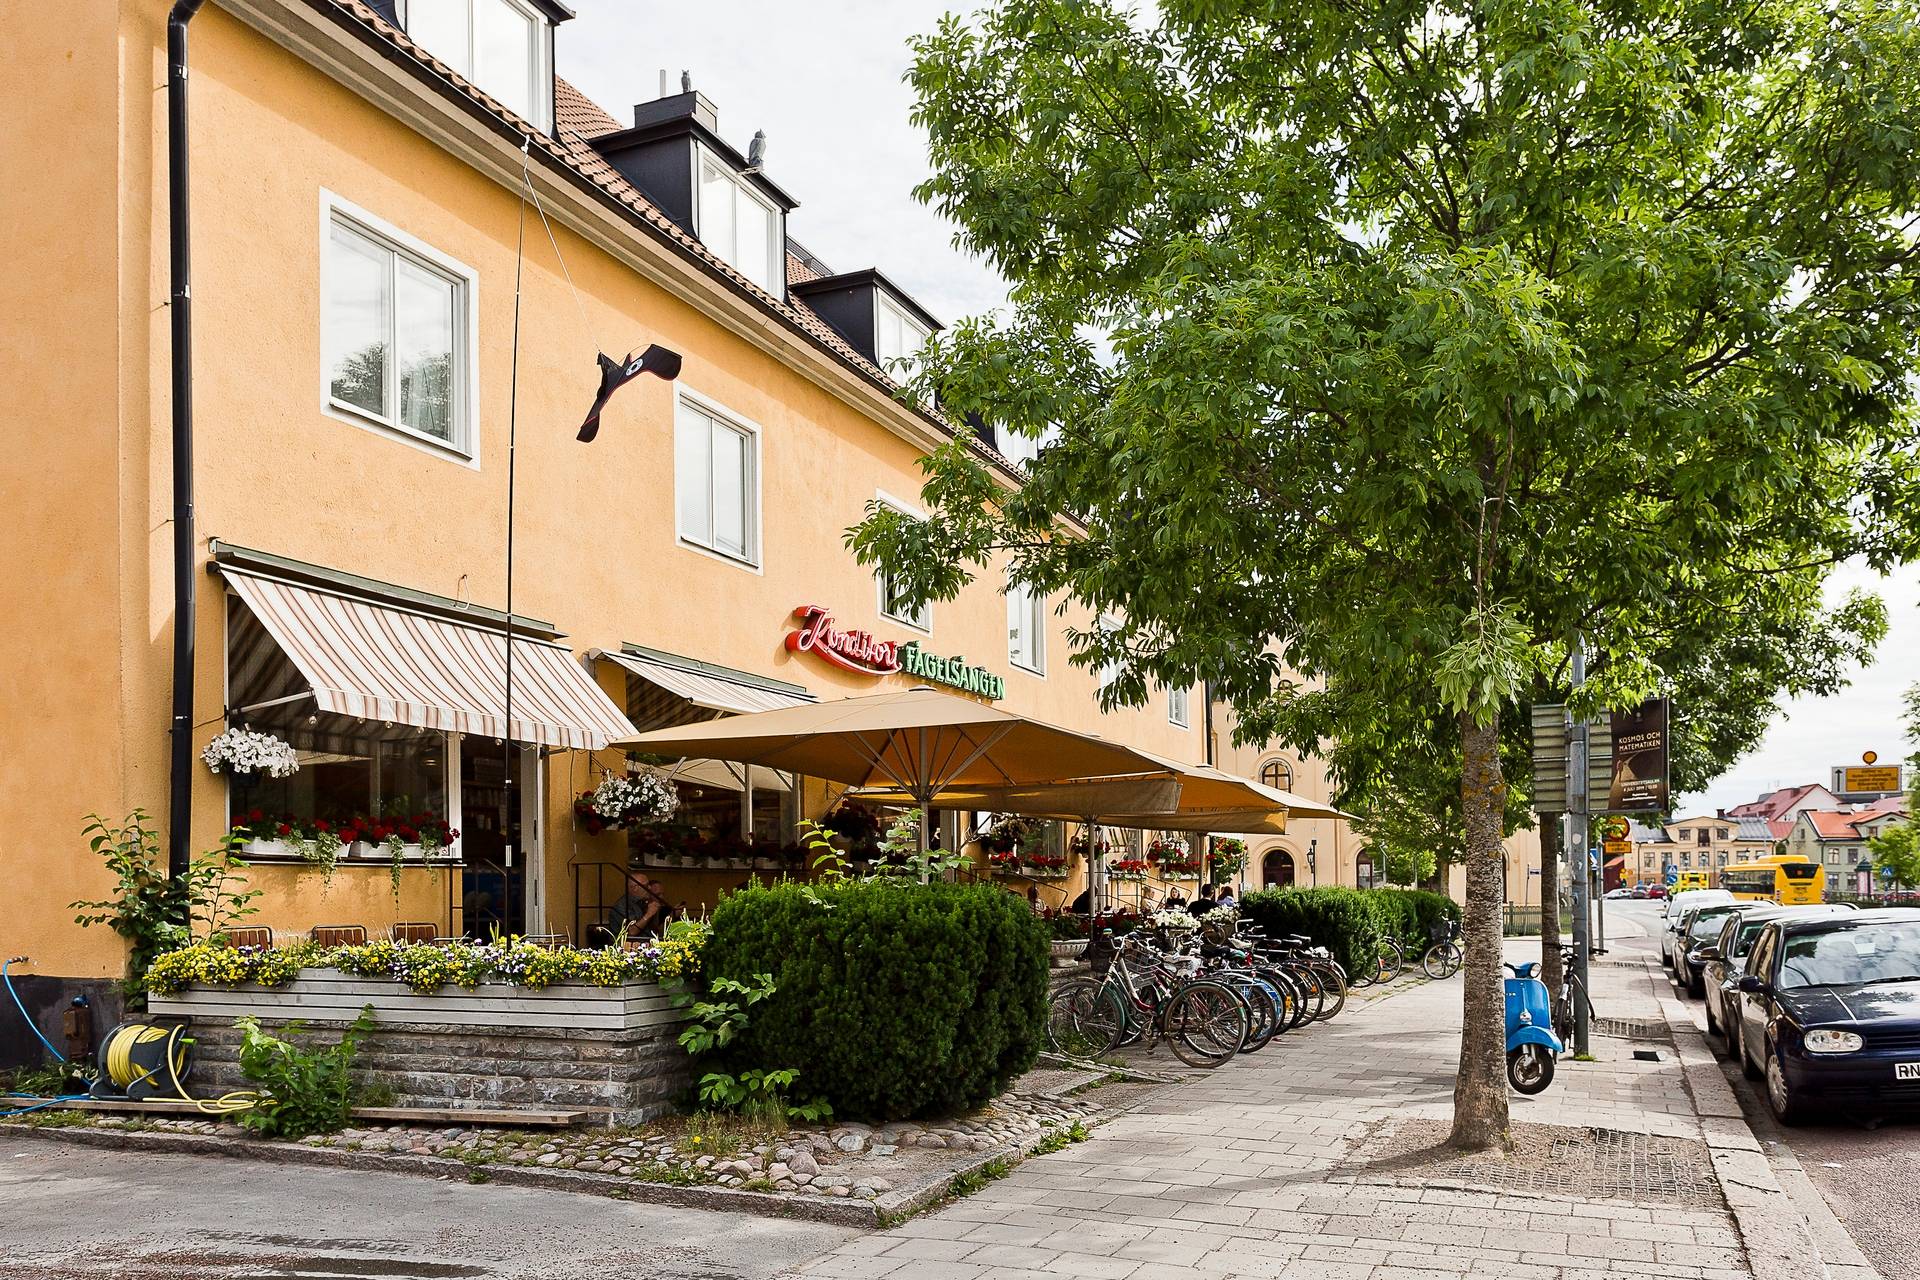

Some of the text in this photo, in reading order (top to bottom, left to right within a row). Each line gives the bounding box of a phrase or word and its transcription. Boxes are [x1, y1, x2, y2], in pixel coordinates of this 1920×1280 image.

[787, 605, 1005, 700] Konditori FÅGELSÅNGEN
[1619, 734, 1644, 744] KOSMOS
[1619, 740, 1660, 751] MATEMATIKEN
[1898, 1064, 1920, 1078] RN
